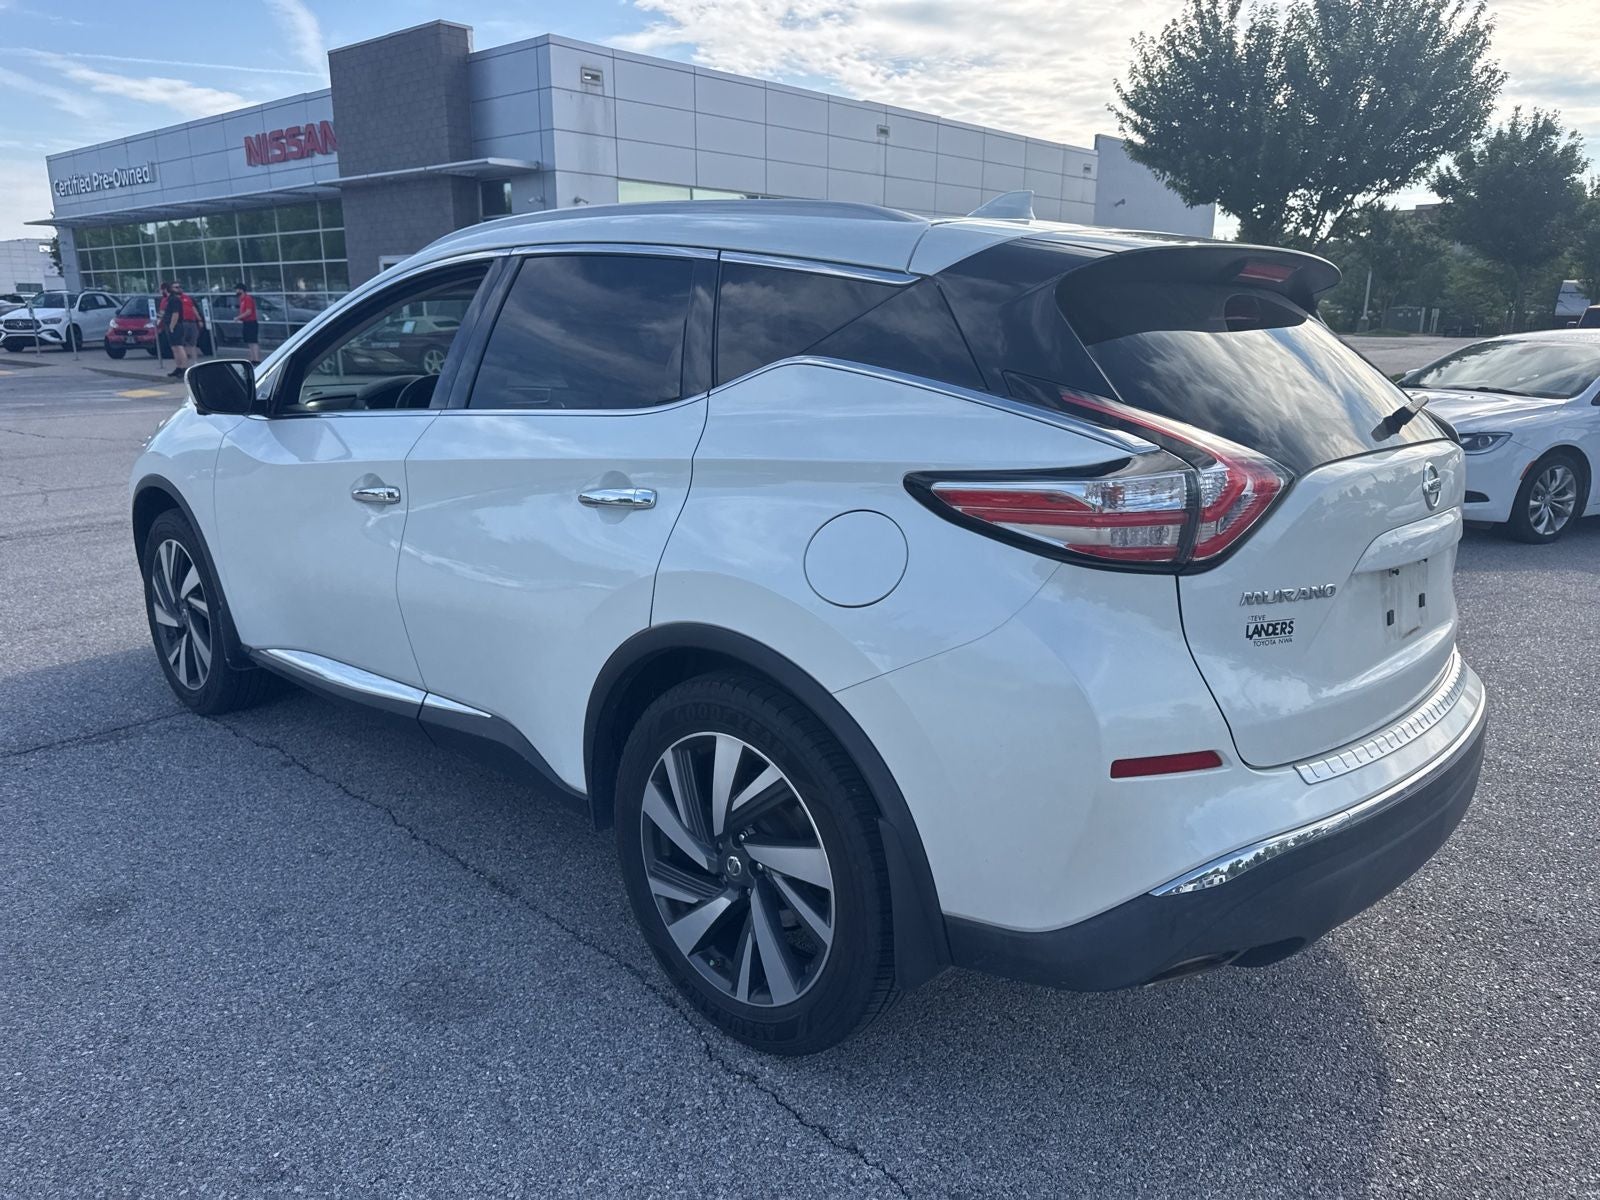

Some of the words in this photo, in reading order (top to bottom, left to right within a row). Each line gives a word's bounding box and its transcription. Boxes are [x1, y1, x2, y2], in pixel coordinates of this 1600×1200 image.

[244, 120, 337, 166] NISSAN
[54, 173, 92, 196] Certified
[93, 161, 152, 191] Pre-Owned
[1239, 584, 1336, 606] MURANO
[1246, 621, 1294, 640] LANDERS
[1253, 639, 1276, 647] TOYOTA
[1278, 637, 1293, 645] NWA
